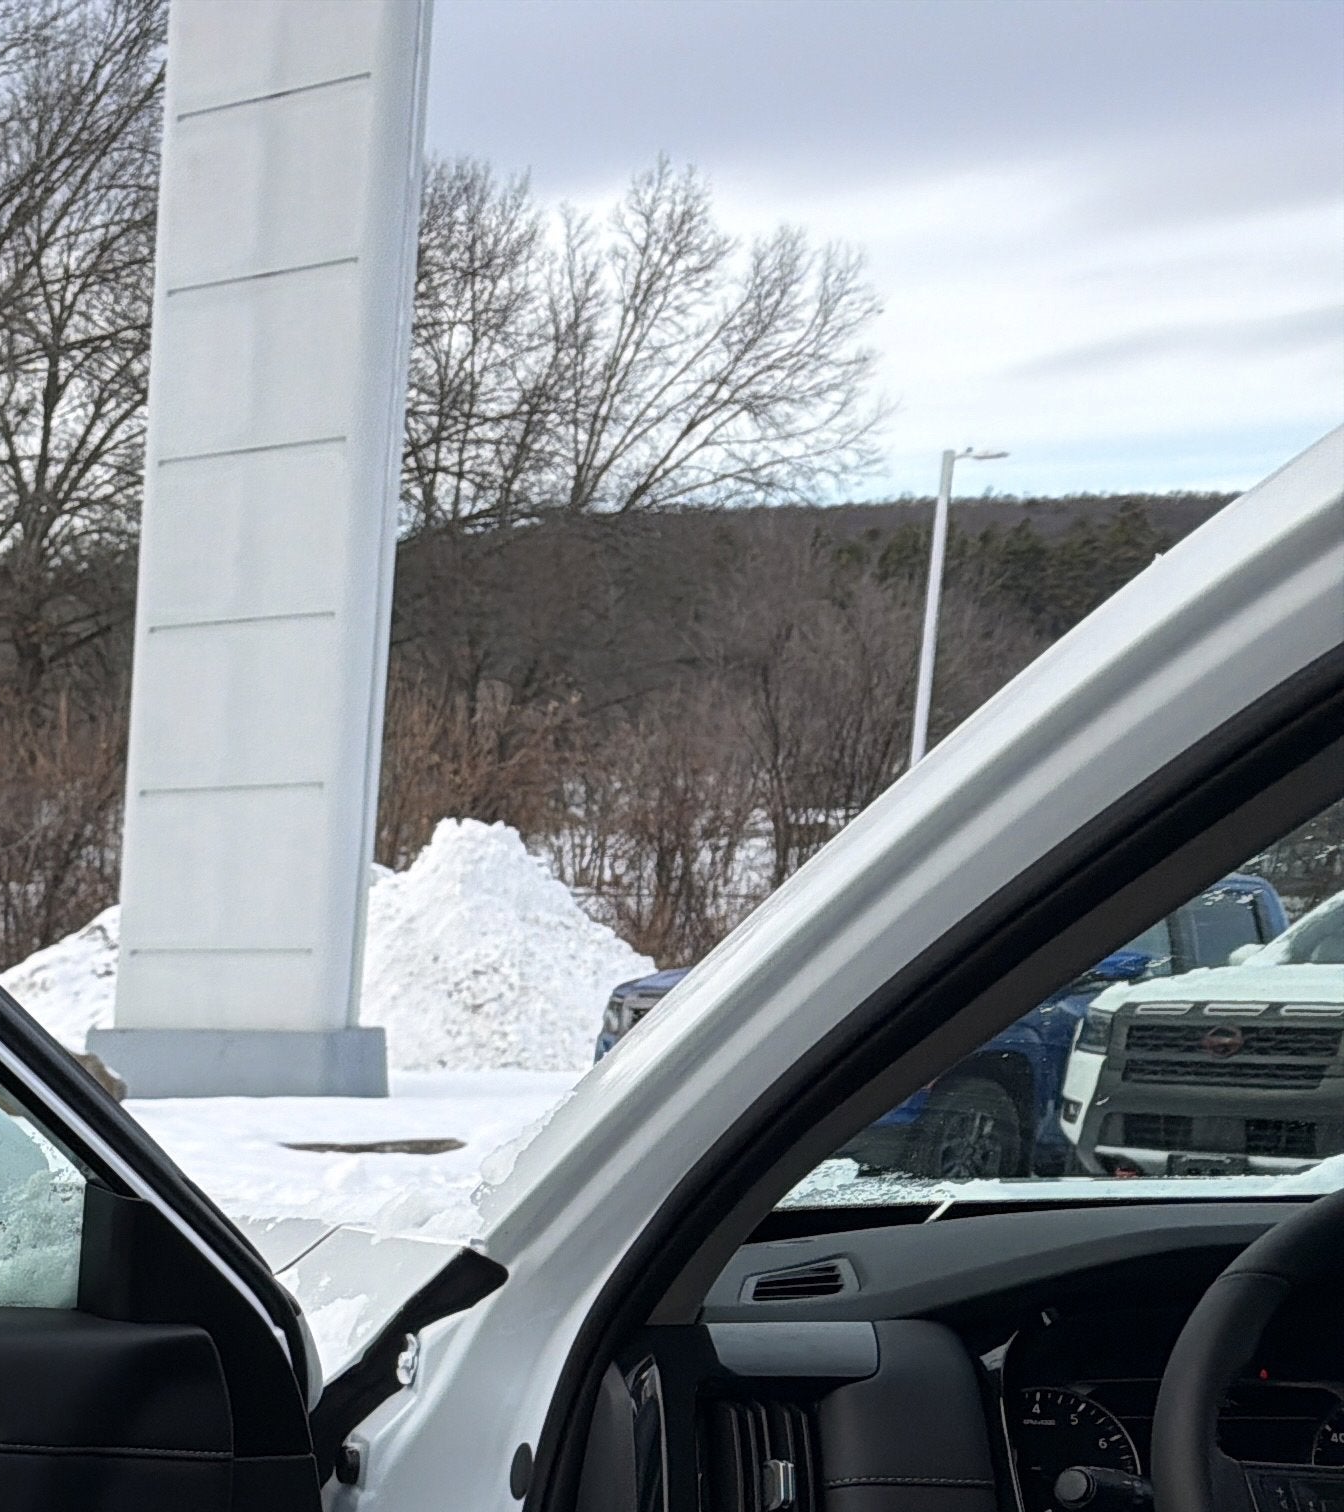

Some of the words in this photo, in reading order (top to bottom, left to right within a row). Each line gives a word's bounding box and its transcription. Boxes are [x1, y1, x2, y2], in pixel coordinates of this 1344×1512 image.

[1031, 1403, 1040, 1414] 4
[1070, 1414, 1079, 1425] 5
[1098, 1438, 1108, 1449] 6
